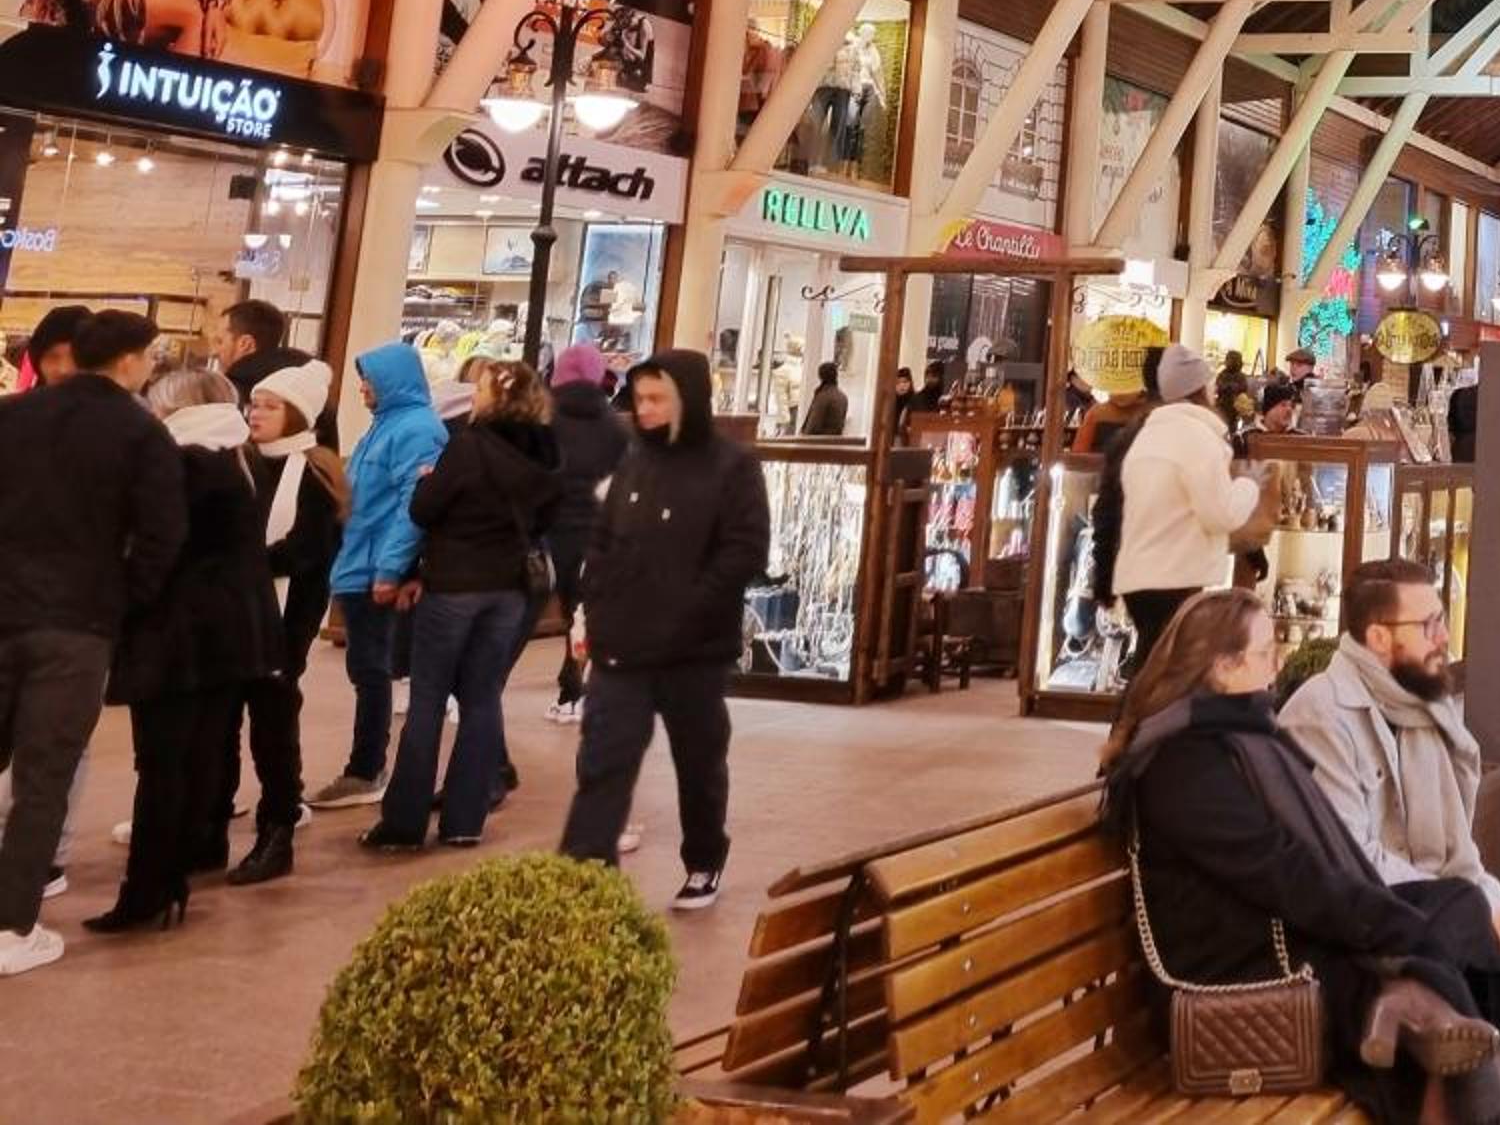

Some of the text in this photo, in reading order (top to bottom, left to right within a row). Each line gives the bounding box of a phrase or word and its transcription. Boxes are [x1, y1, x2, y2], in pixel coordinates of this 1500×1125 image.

[118, 61, 279, 123] INTUIÇÃO
[226, 118, 273, 140] STORE
[520, 153, 655, 200] attach
